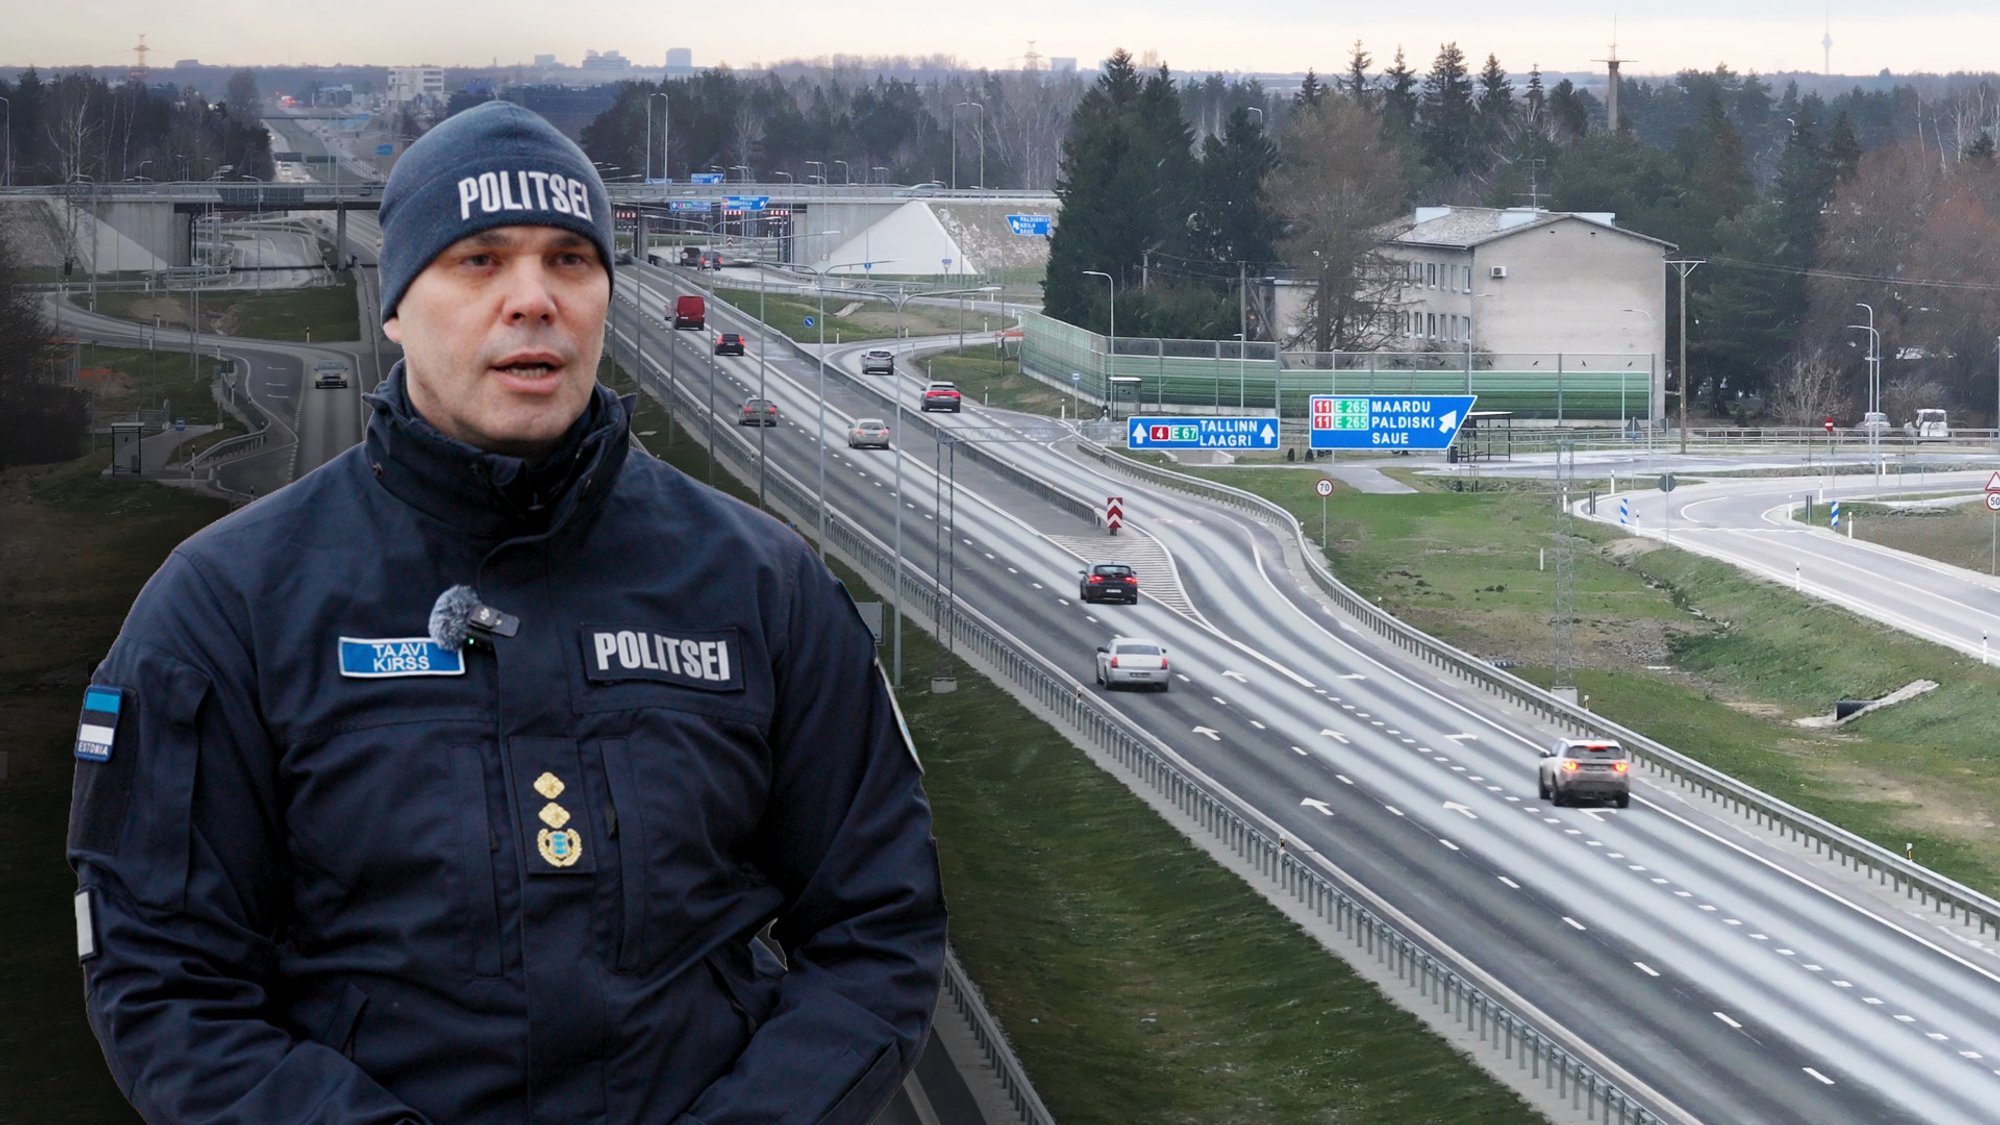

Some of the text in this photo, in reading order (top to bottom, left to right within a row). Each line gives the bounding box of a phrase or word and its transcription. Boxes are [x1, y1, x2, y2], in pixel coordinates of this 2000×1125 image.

[457, 170, 593, 222] POLITSEI
[1316, 401, 1431, 412] 11 E 265 MAARDU
[1199, 420, 1258, 432] TALLINN
[1316, 417, 1435, 428] 11 E 265 PALDISKI
[1156, 427, 1197, 439] 4 E 67
[1371, 432, 1409, 444] SAUE
[1199, 434, 1252, 447] LAAGRI
[1319, 483, 1330, 492] 70
[372, 642, 428, 658] TAAVI
[593, 630, 731, 681] POLITSEI
[373, 656, 430, 672] KIRSS
